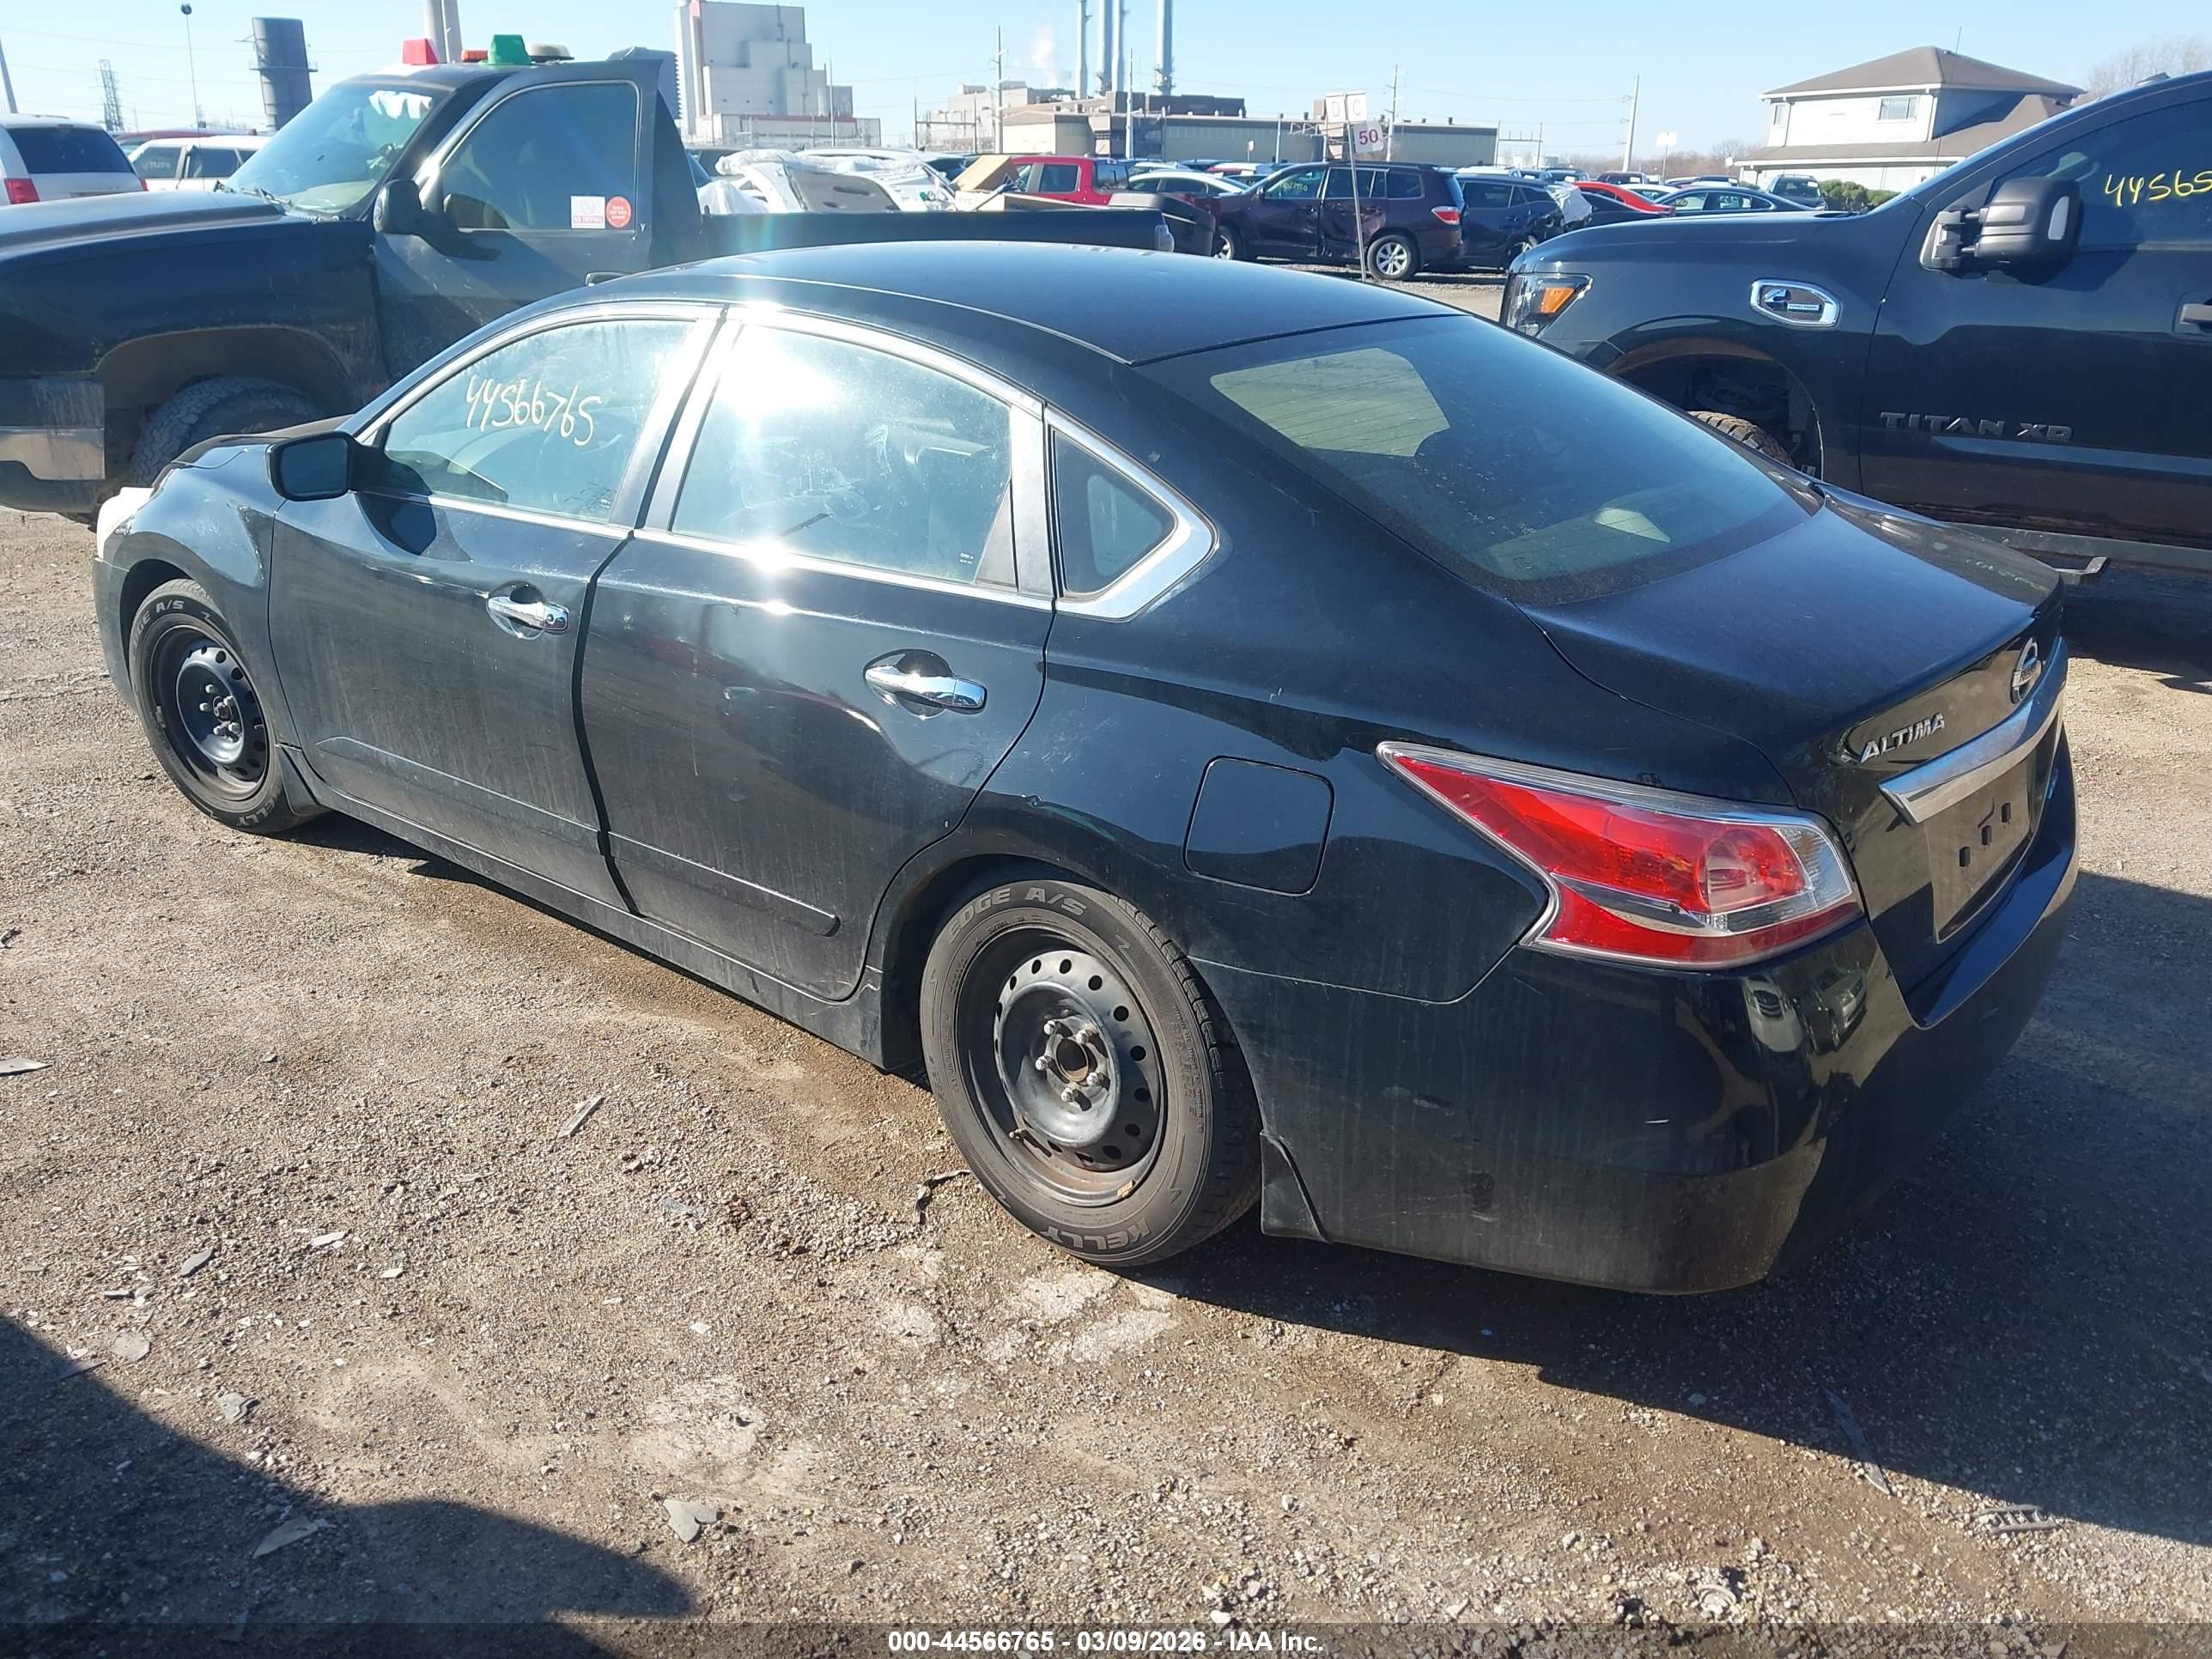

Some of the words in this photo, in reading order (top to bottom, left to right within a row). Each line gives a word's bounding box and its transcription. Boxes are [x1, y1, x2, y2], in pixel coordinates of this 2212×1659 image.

[1358, 129, 1379, 146] 50
[465, 373, 603, 447] 44566765
[1881, 411, 2005, 437] TITAN
[2017, 422, 2074, 441] XD
[155, 599, 185, 613] A/S
[1860, 713, 1946, 763] ALTIMA
[948, 888, 1011, 945] EDGE
[1025, 887, 1088, 916] A/S
[1039, 1217, 1152, 1251] KELLY
